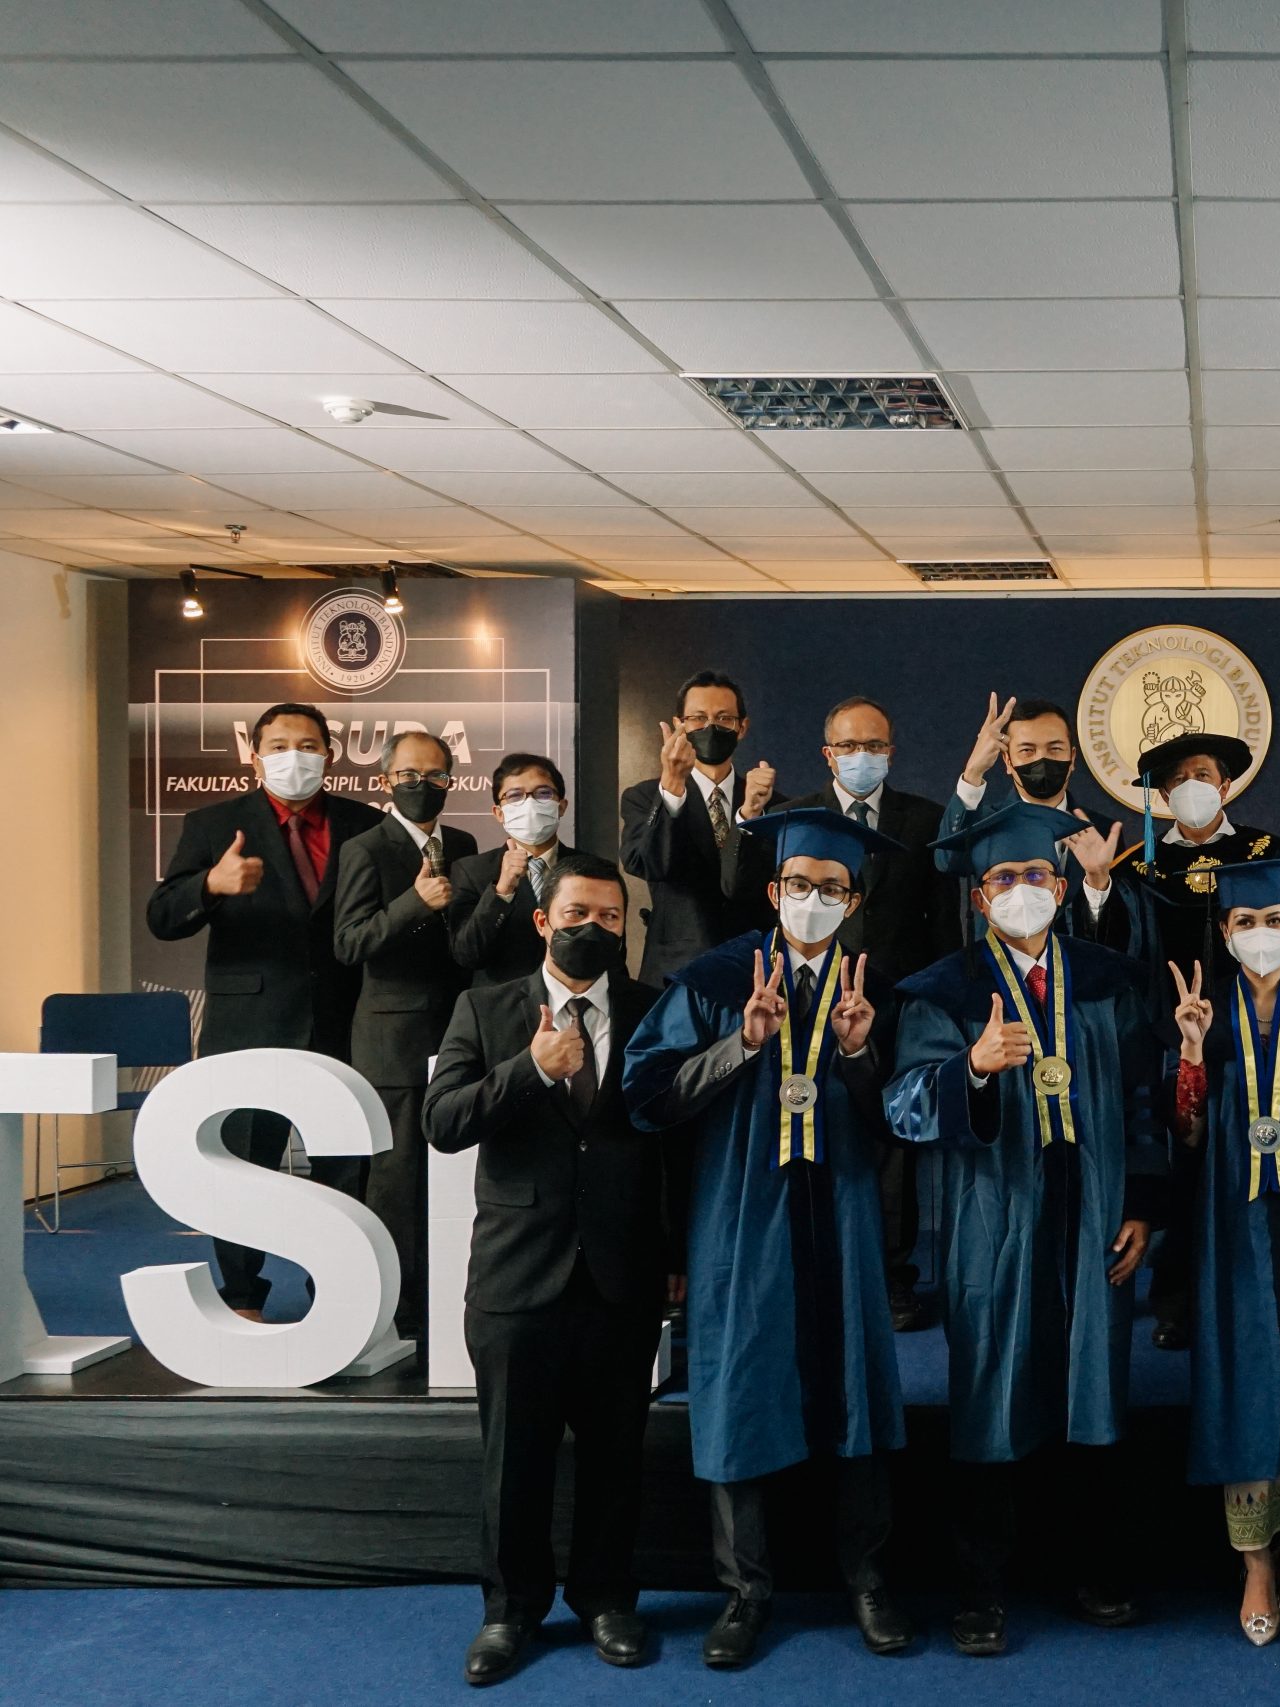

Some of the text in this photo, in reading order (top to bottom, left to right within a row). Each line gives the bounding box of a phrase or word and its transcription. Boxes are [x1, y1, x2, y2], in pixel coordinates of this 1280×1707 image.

[311, 600, 394, 673] INSTITUT TEKNOLOGI BANDUNG
[340, 674, 366, 682] 1920
[1088, 636, 1262, 777] INSTITUT TEKNOLOGI BANDU
[233, 720, 472, 765] WSUA
[166, 776, 249, 792] FAKULTAS
[323, 776, 362, 791] SIPIL
